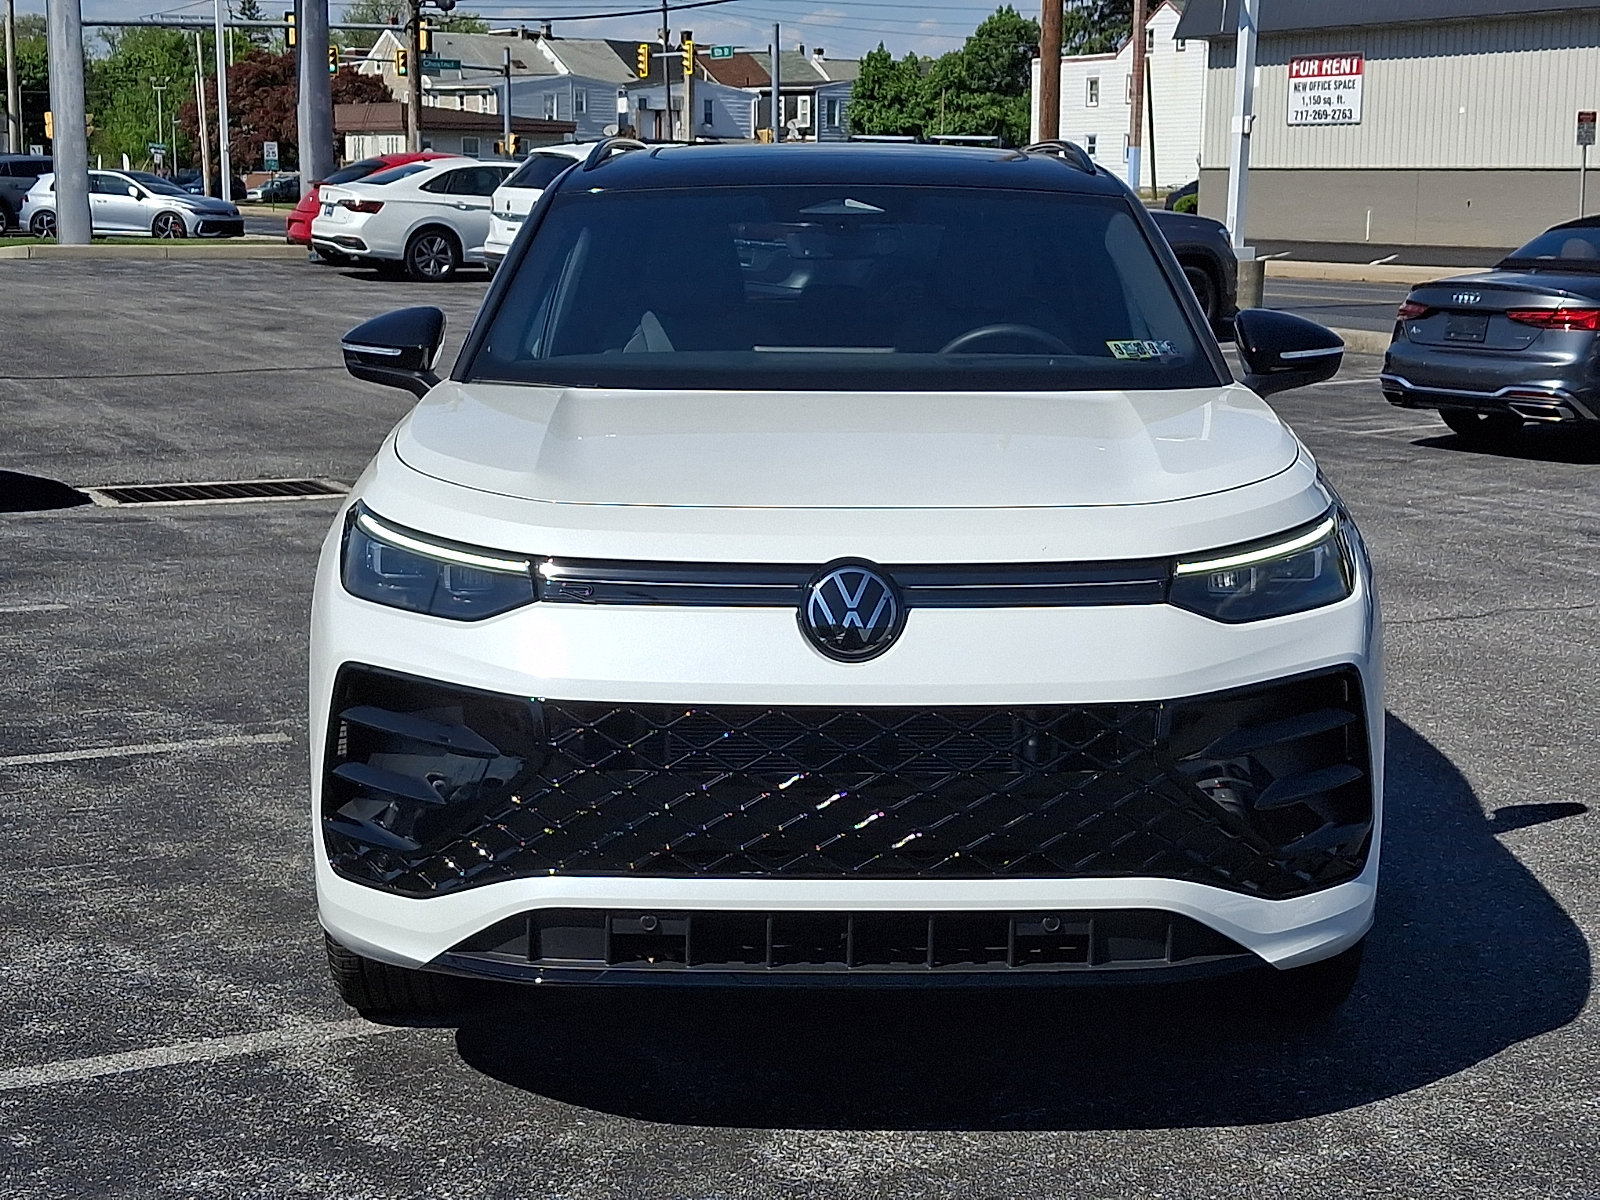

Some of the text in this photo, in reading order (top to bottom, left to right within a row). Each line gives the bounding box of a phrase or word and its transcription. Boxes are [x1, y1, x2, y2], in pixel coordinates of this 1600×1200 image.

[1292, 57, 1359, 76] FOR RENT
[1294, 79, 1356, 93] NEW OFFICE SPACE
[1302, 94, 1346, 107] 1,150 sq. ft.
[1294, 108, 1353, 120] 717-269-2763
